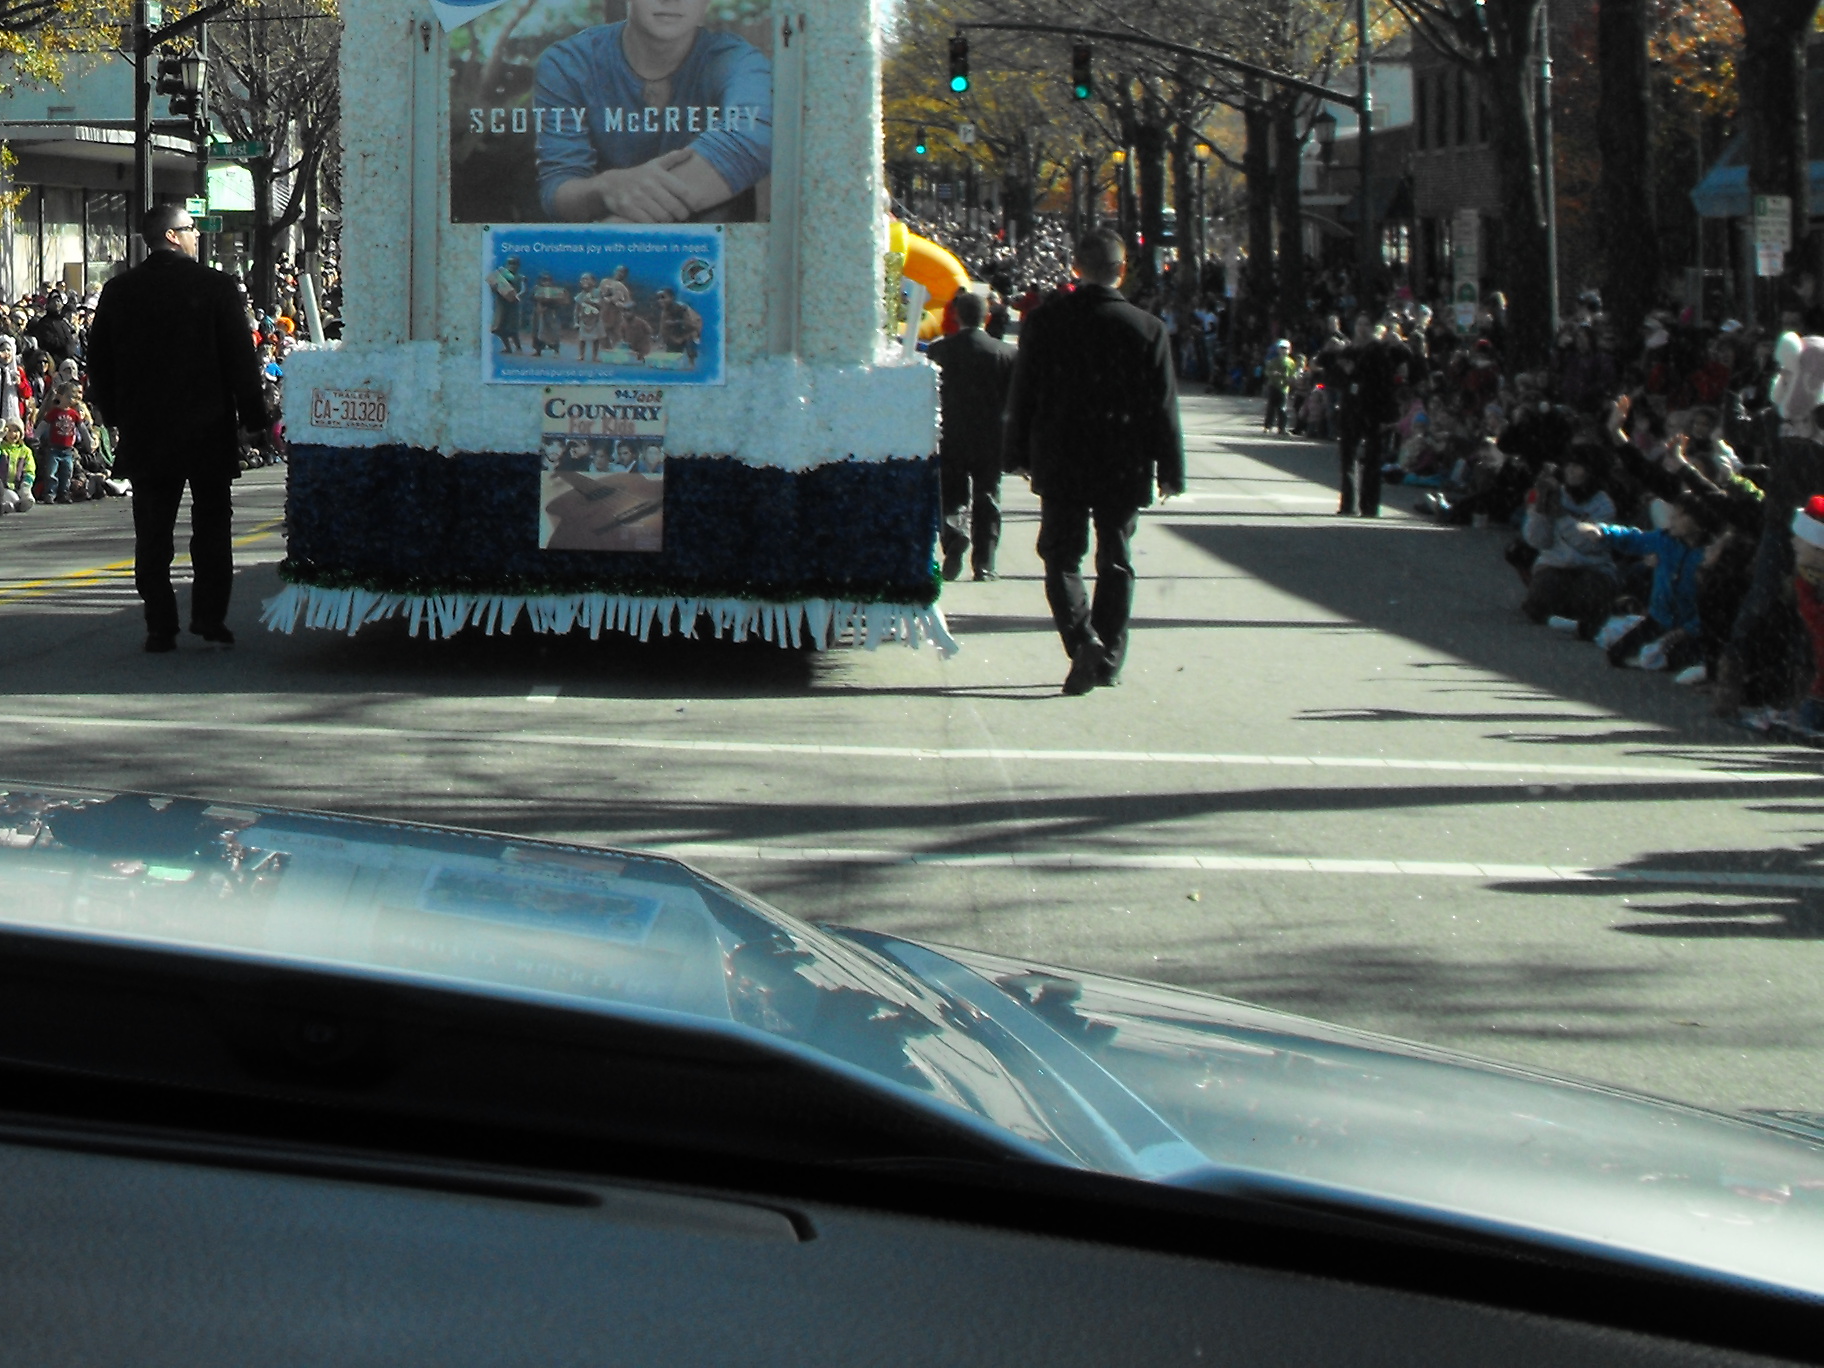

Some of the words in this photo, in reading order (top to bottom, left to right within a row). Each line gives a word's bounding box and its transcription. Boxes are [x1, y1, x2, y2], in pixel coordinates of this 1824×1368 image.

[469, 107, 587, 133] SCOTTY
[604, 106, 759, 132] McCREERY
[501, 242, 530, 253] Share
[533, 242, 584, 253] Christmas
[586, 243, 602, 255] joy
[604, 242, 625, 253] with
[627, 242, 667, 253] children
[671, 243, 679, 253] in
[314, 399, 385, 423] CA-31320
